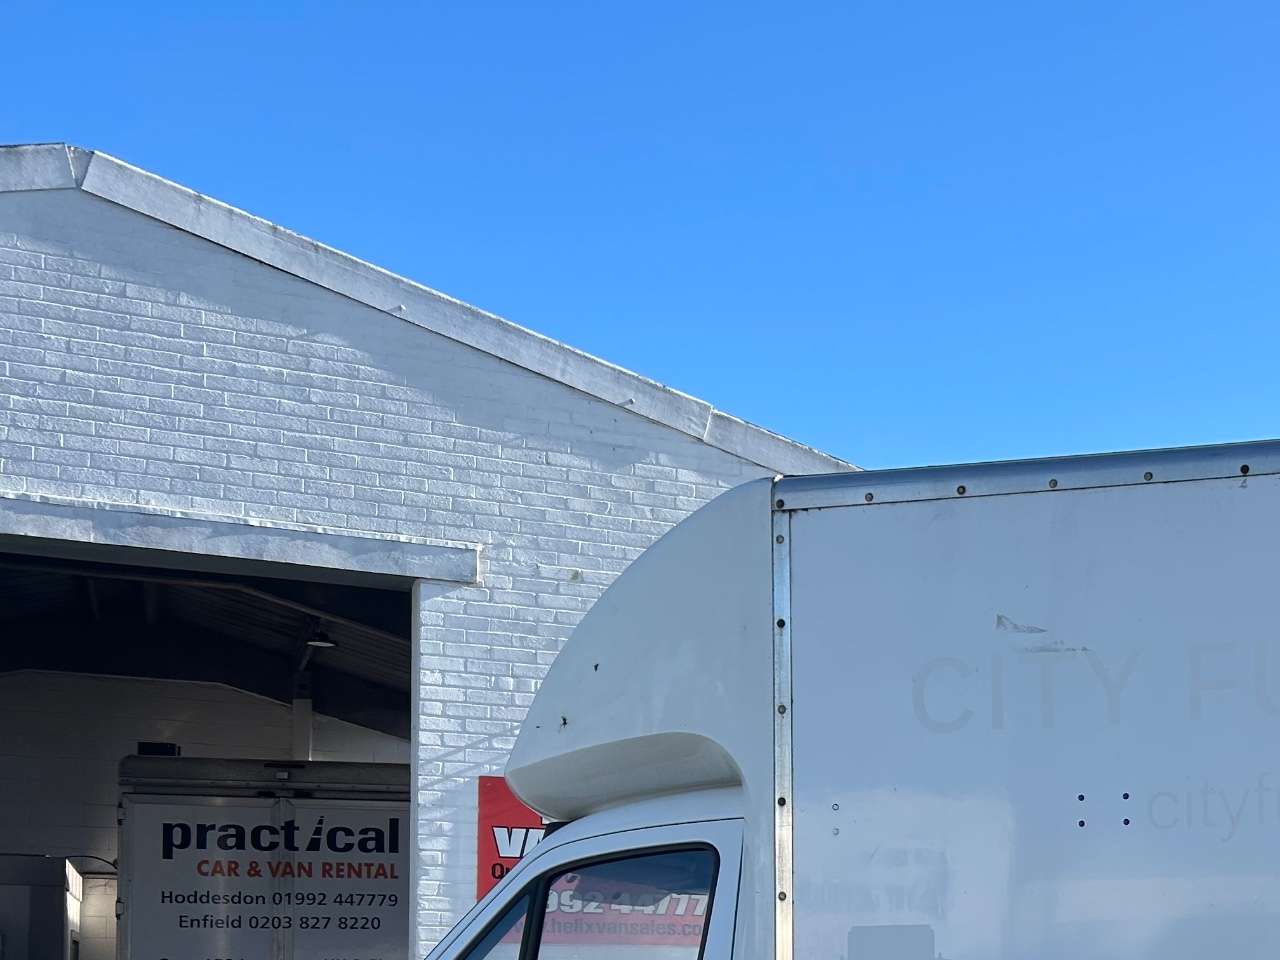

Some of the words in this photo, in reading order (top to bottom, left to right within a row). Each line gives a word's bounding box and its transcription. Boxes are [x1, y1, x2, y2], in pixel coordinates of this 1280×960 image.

[910, 647, 1141, 734] CITY
[162, 816, 400, 860] practical
[196, 860, 240, 878] CAR
[246, 860, 263, 878] &
[267, 861, 314, 879] VAN
[321, 862, 399, 880] RENTAL
[160, 890, 266, 906] Hoddesdon
[271, 892, 327, 907] 01992
[333, 893, 399, 907] 447779
[178, 914, 242, 929] Enfield
[248, 915, 293, 930] 0203
[299, 916, 332, 930] 827
[337, 916, 381, 930] 8220
